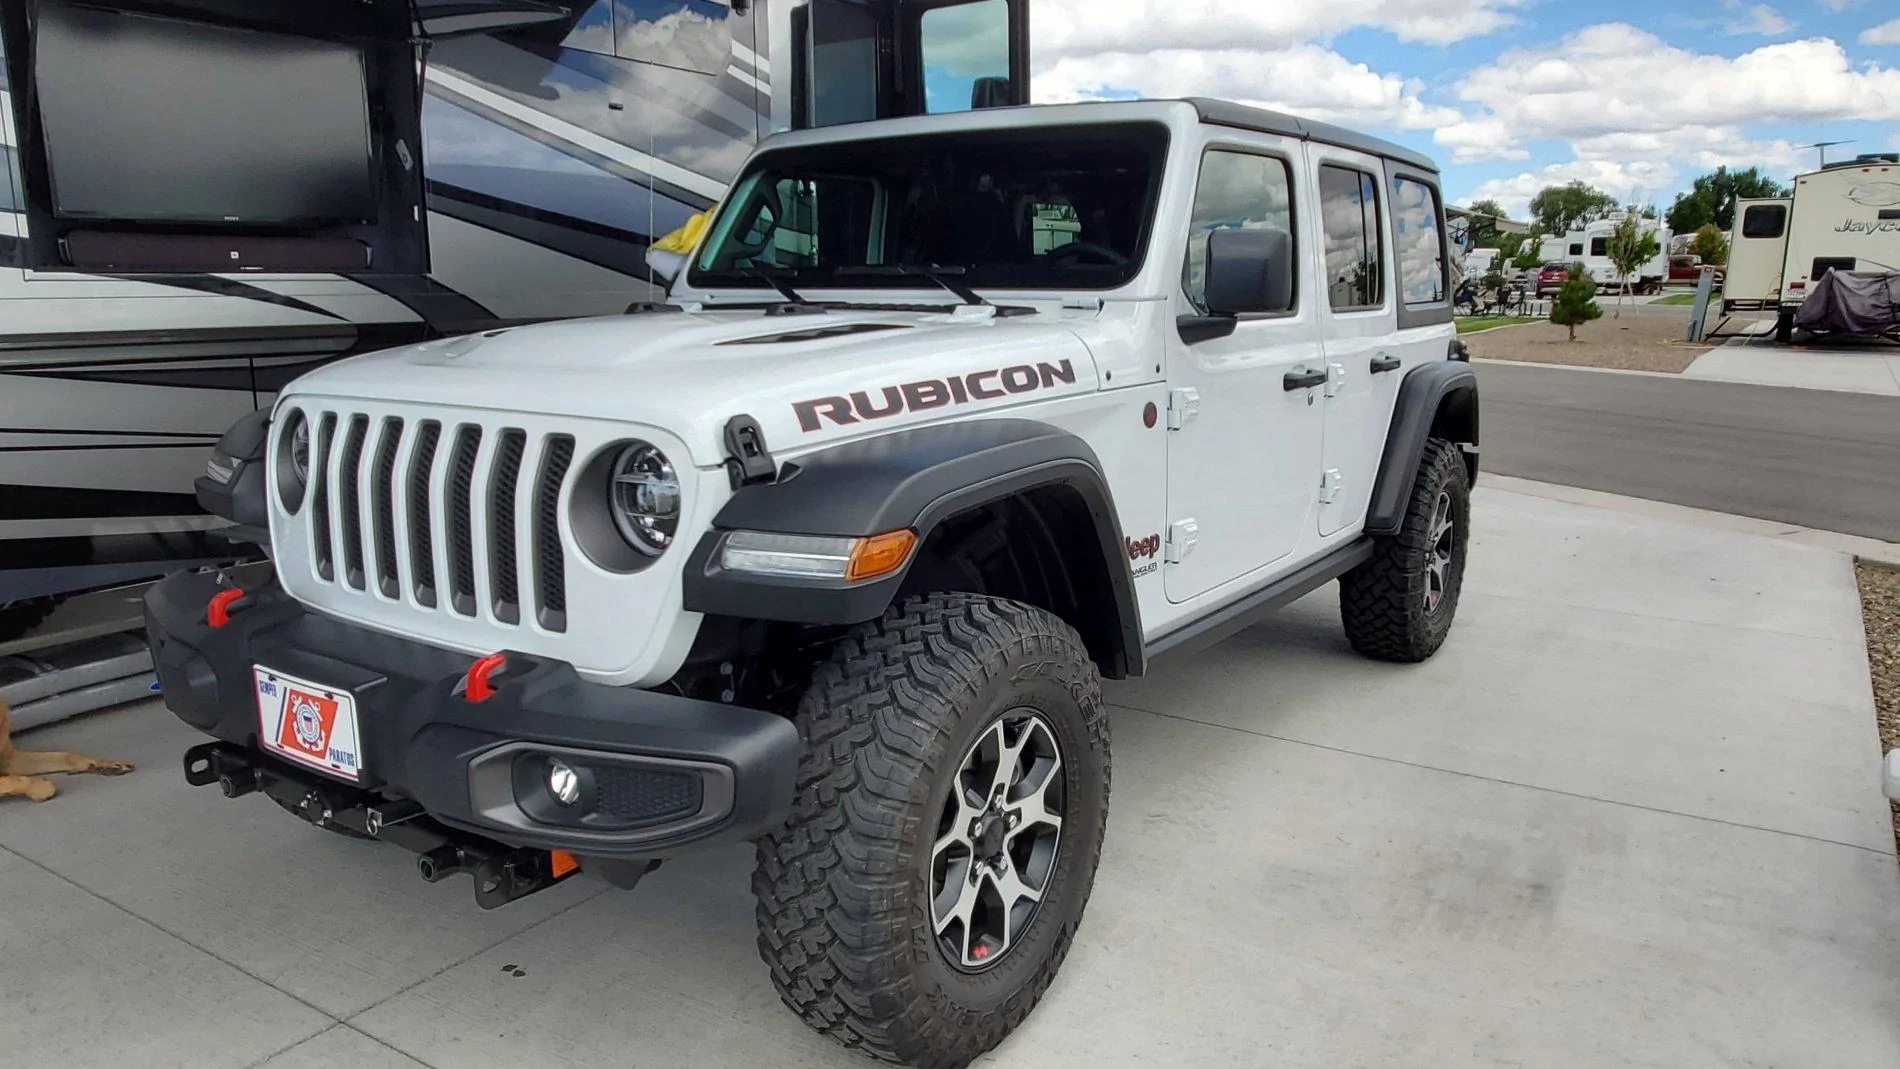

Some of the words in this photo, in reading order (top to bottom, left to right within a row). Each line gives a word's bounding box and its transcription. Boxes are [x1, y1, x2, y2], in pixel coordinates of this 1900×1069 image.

[791, 359, 1076, 433] RUBICON
[260, 680, 278, 697] SEMPER
[329, 747, 354, 767] PARATUS
